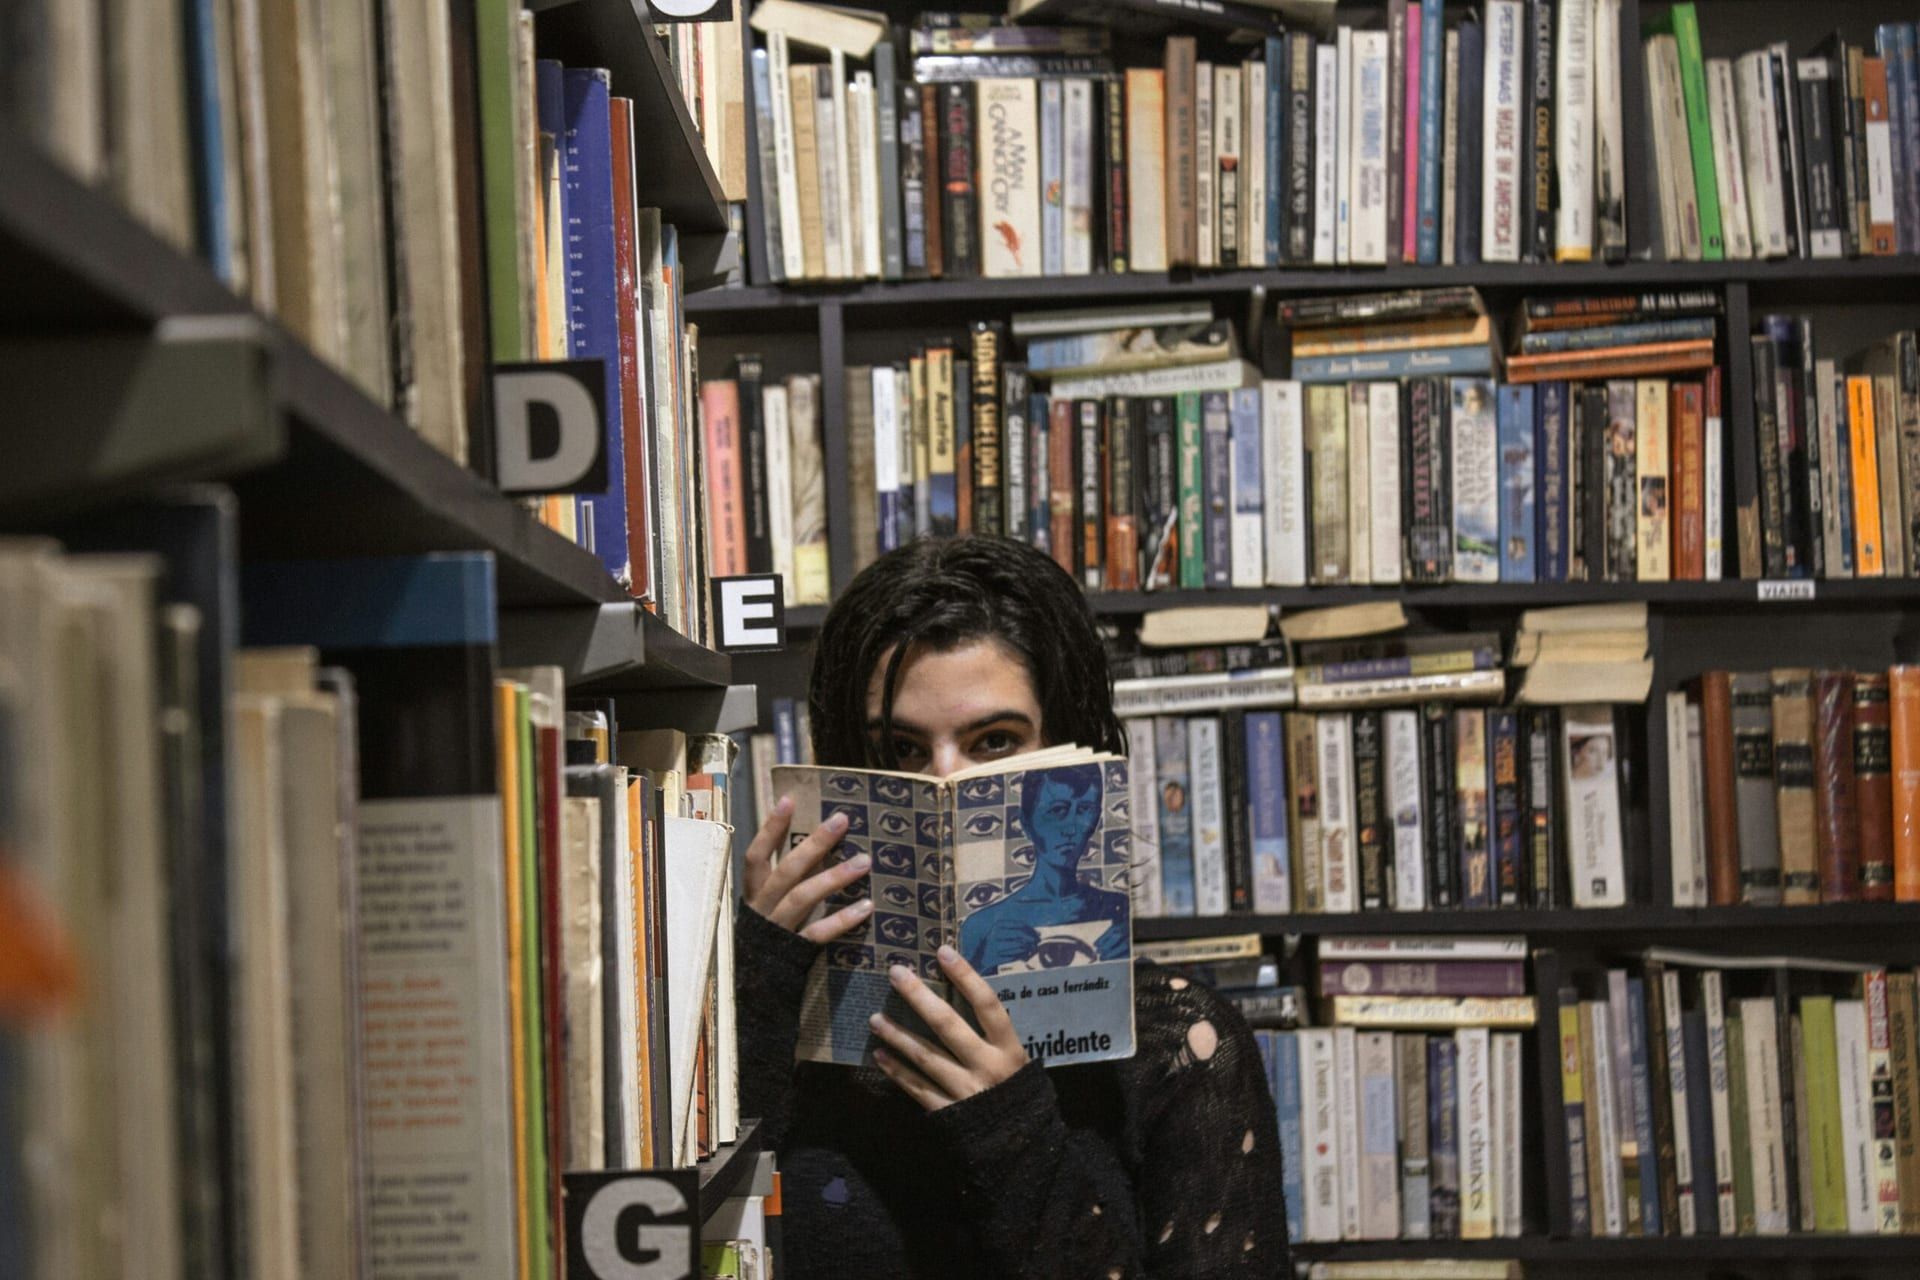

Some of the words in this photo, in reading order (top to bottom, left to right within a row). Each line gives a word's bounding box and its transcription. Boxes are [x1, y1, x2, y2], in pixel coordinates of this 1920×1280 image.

[989, 103, 1010, 175] CANNOT
[1007, 127, 1023, 142] A
[1494, 108, 1514, 152] MADE
[990, 177, 1010, 215] CRY
[1005, 143, 1027, 190] MAN
[1493, 178, 1514, 246] AMERICA
[973, 331, 998, 396] SIDNEY
[493, 371, 600, 492] D
[935, 391, 950, 456] Austria
[973, 402, 998, 488] SHELDON
[720, 579, 779, 646] E
[1762, 584, 1811, 597] VIAJES
[1020, 986, 1032, 998] de
[1037, 985, 1059, 997] casa
[1063, 977, 1110, 993] ferrándiz
[581, 1176, 691, 1280] G
